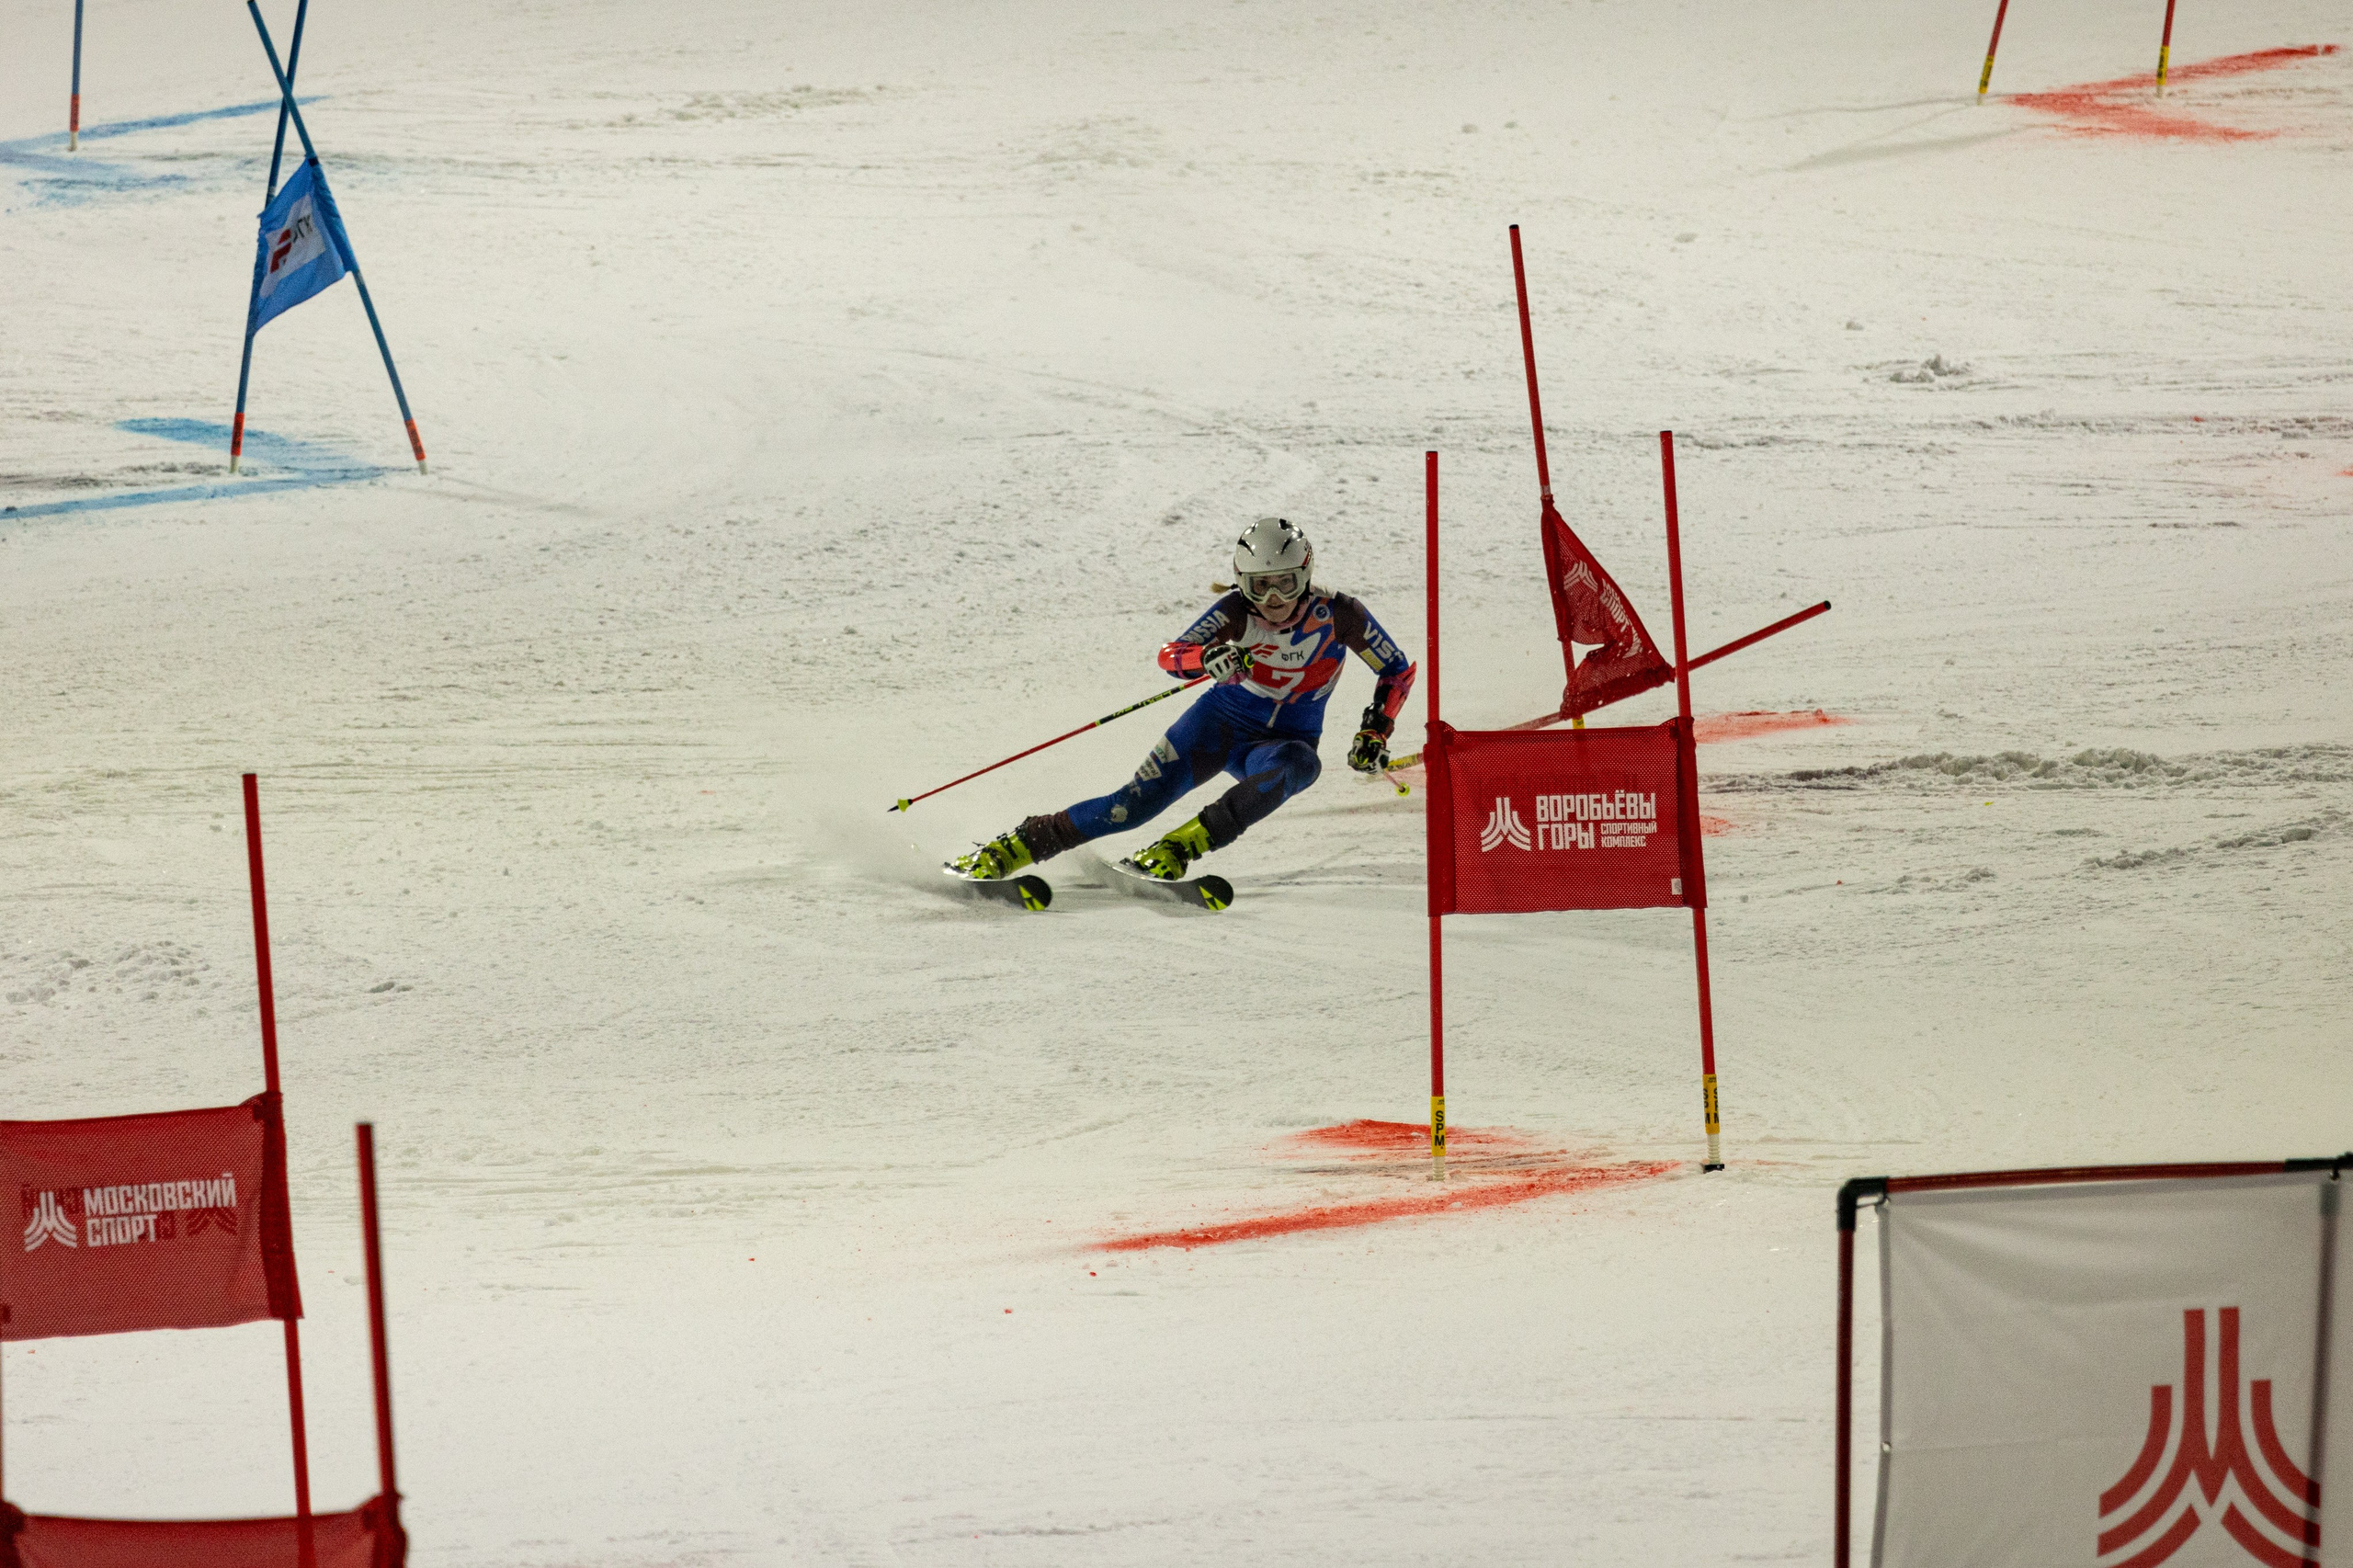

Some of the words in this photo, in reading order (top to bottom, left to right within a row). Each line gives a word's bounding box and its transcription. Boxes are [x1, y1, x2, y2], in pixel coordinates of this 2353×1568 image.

[1179, 609, 1231, 644] RUSSIA
[1271, 669, 1305, 698] 7
[1536, 790, 1656, 822] ВОРОБЬЁВЫ
[1537, 822, 1595, 851] ГОРЫ
[1600, 821, 1657, 835] СПОРТИВНЫЙ
[1601, 835, 1647, 848] КОМПЛЕКС
[82, 1171, 237, 1216] МОСКОВСКИЙ
[86, 1213, 158, 1248] СПОРТ
